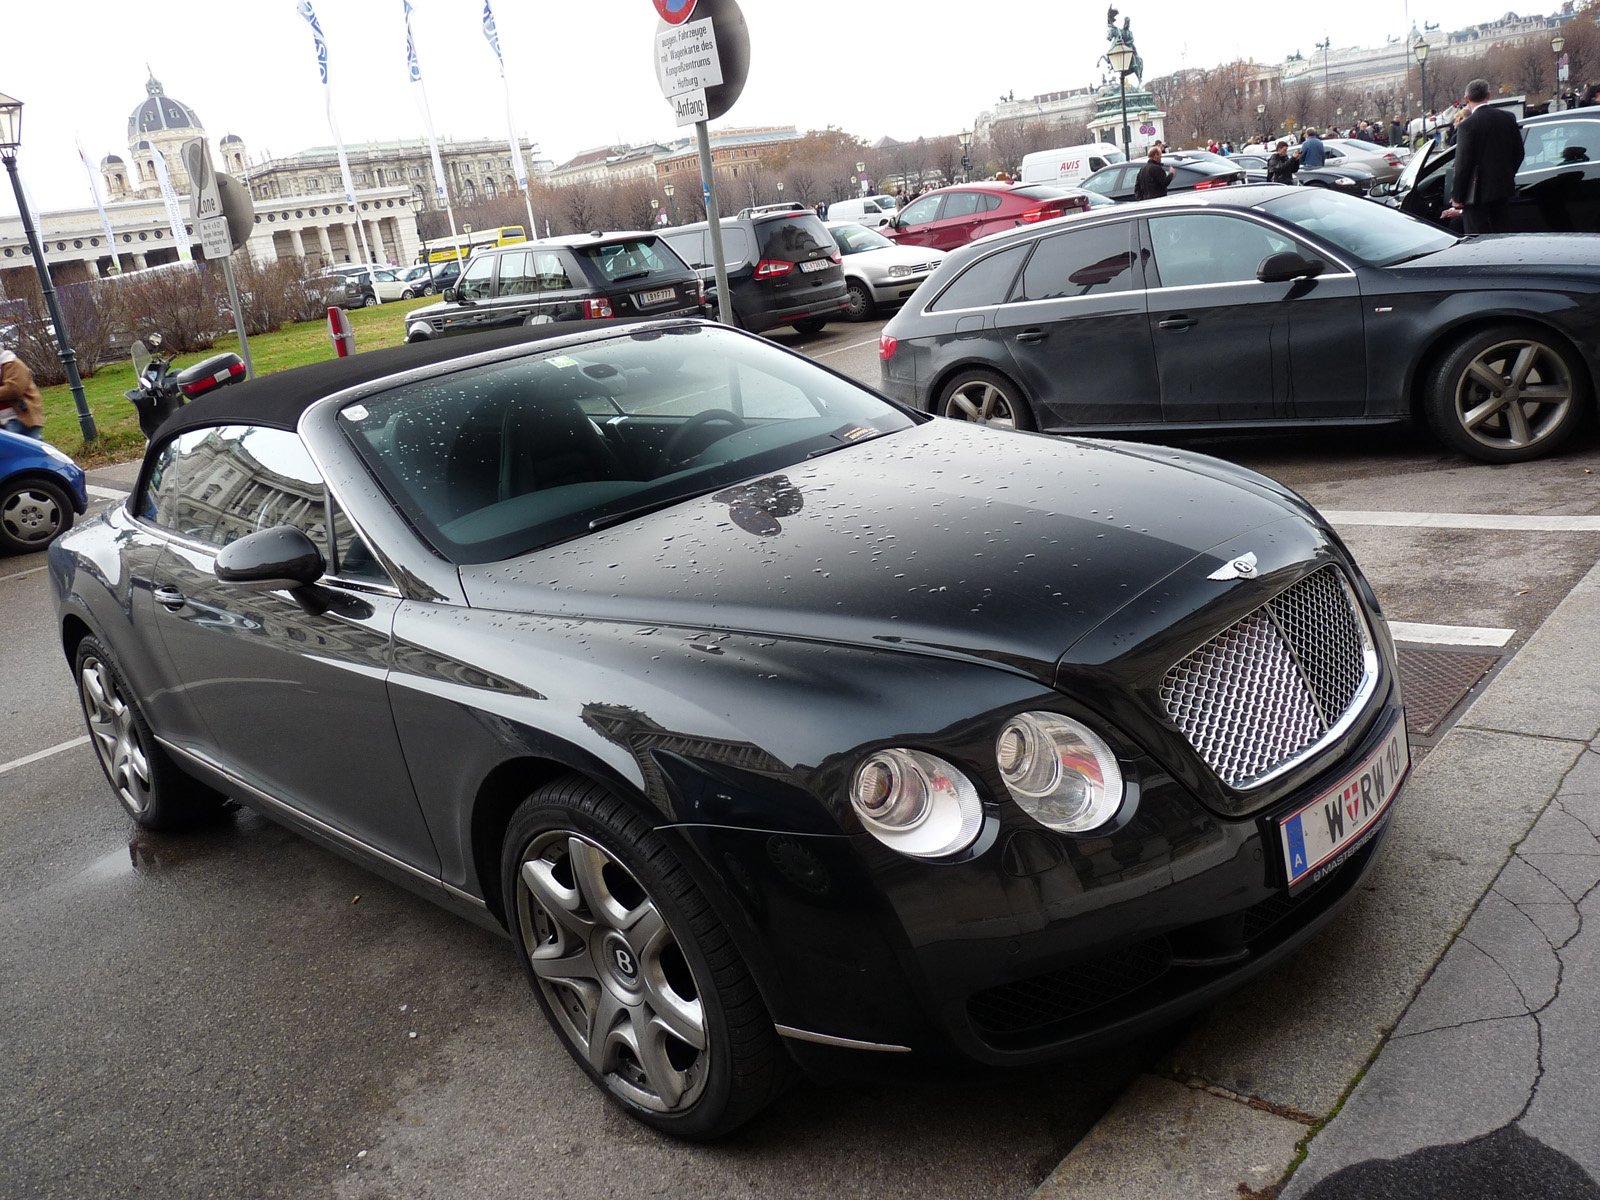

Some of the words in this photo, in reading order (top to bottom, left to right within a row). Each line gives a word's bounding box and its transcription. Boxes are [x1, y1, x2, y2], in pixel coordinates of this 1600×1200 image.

[678, 26, 707, 41] Fahrzeuge
[670, 44, 700, 60] Wagenkarte
[701, 40, 713, 51] des
[677, 76, 699, 89] Hofburg
[677, 97, 704, 117] Anfang
[1060, 159, 1080, 171] AVIS
[661, 289, 671, 299] 777
[1324, 793, 1344, 844] W
[1360, 755, 1385, 817] RW
[1386, 736, 1400, 784] 10
[1295, 854, 1303, 868] A
